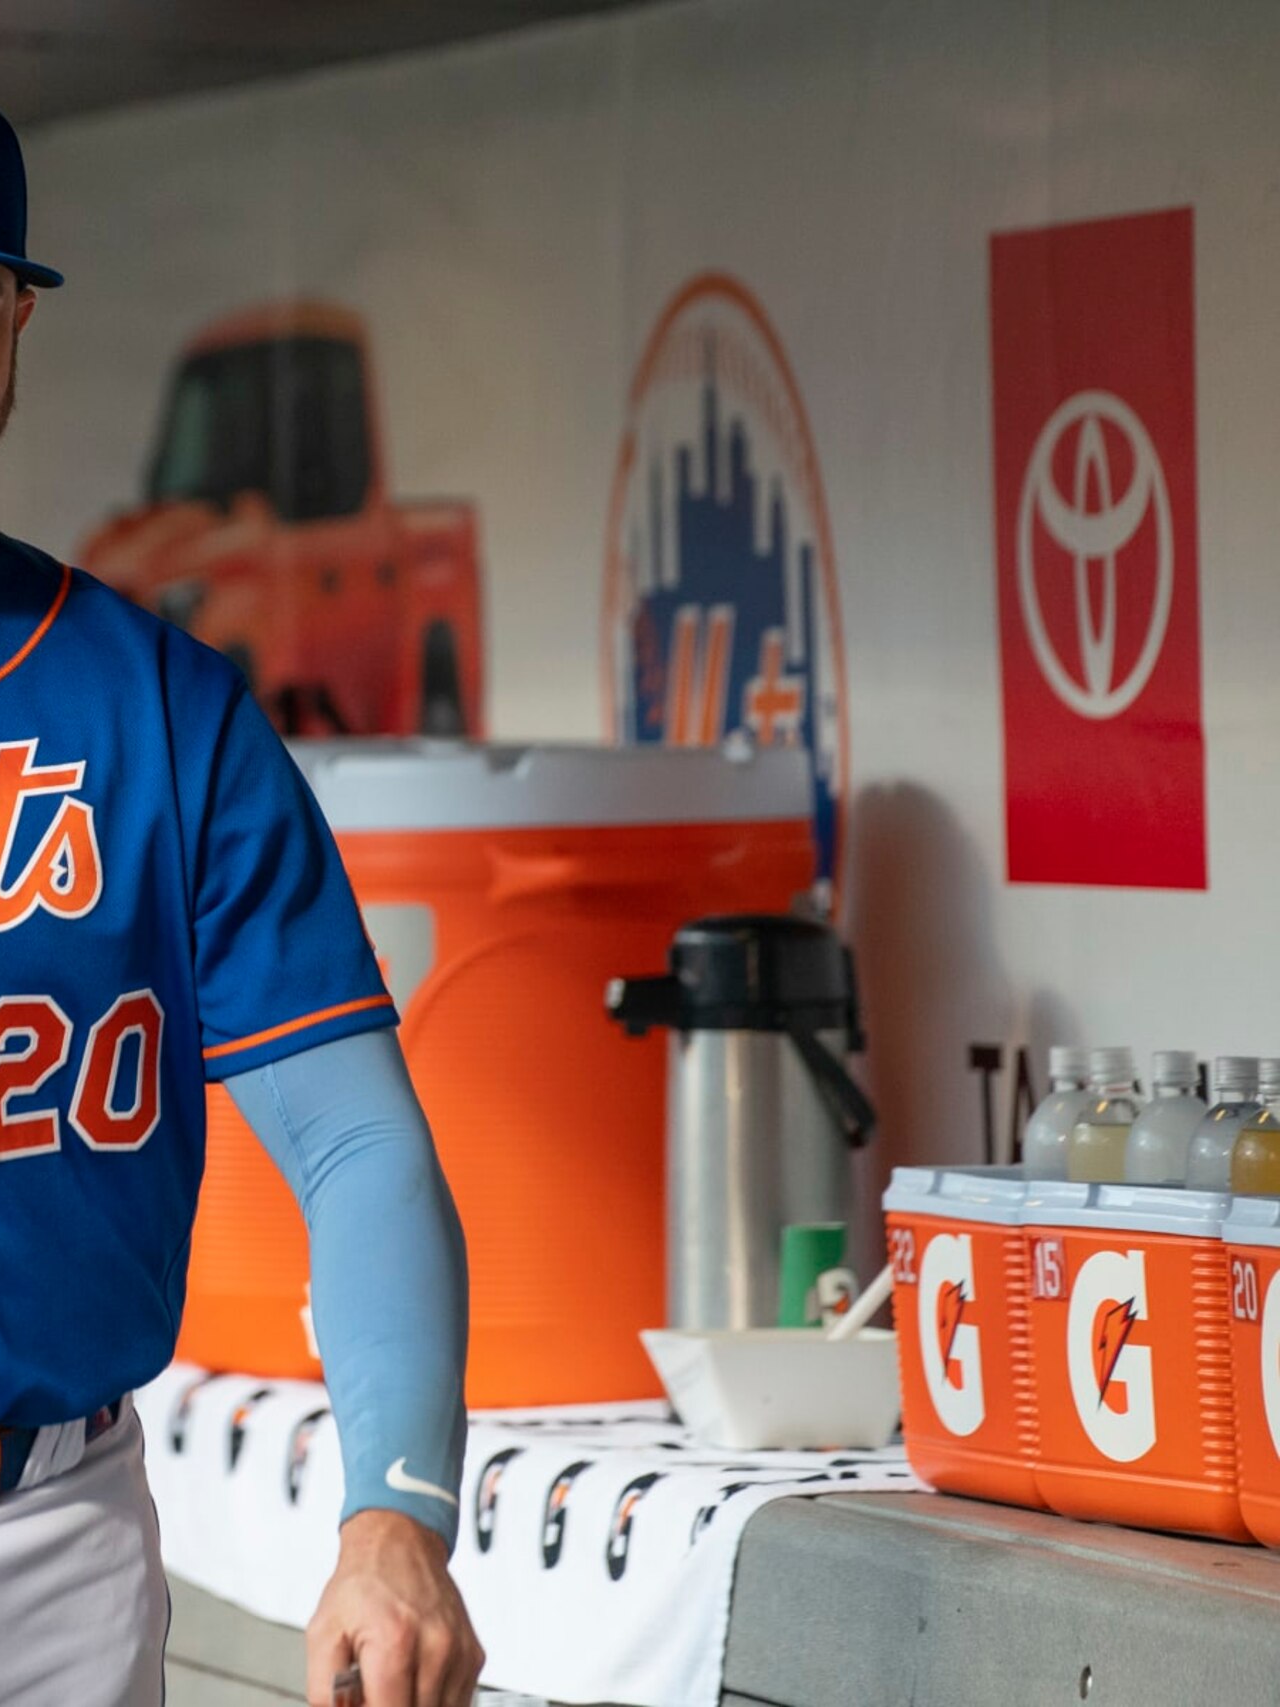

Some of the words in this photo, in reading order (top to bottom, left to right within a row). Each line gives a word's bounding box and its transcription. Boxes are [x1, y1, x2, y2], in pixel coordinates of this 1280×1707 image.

[918, 1233, 985, 1437] G
[1033, 1240, 1061, 1298] 15
[1232, 1260, 1258, 1320] 20
[1067, 1249, 1156, 1462] G
